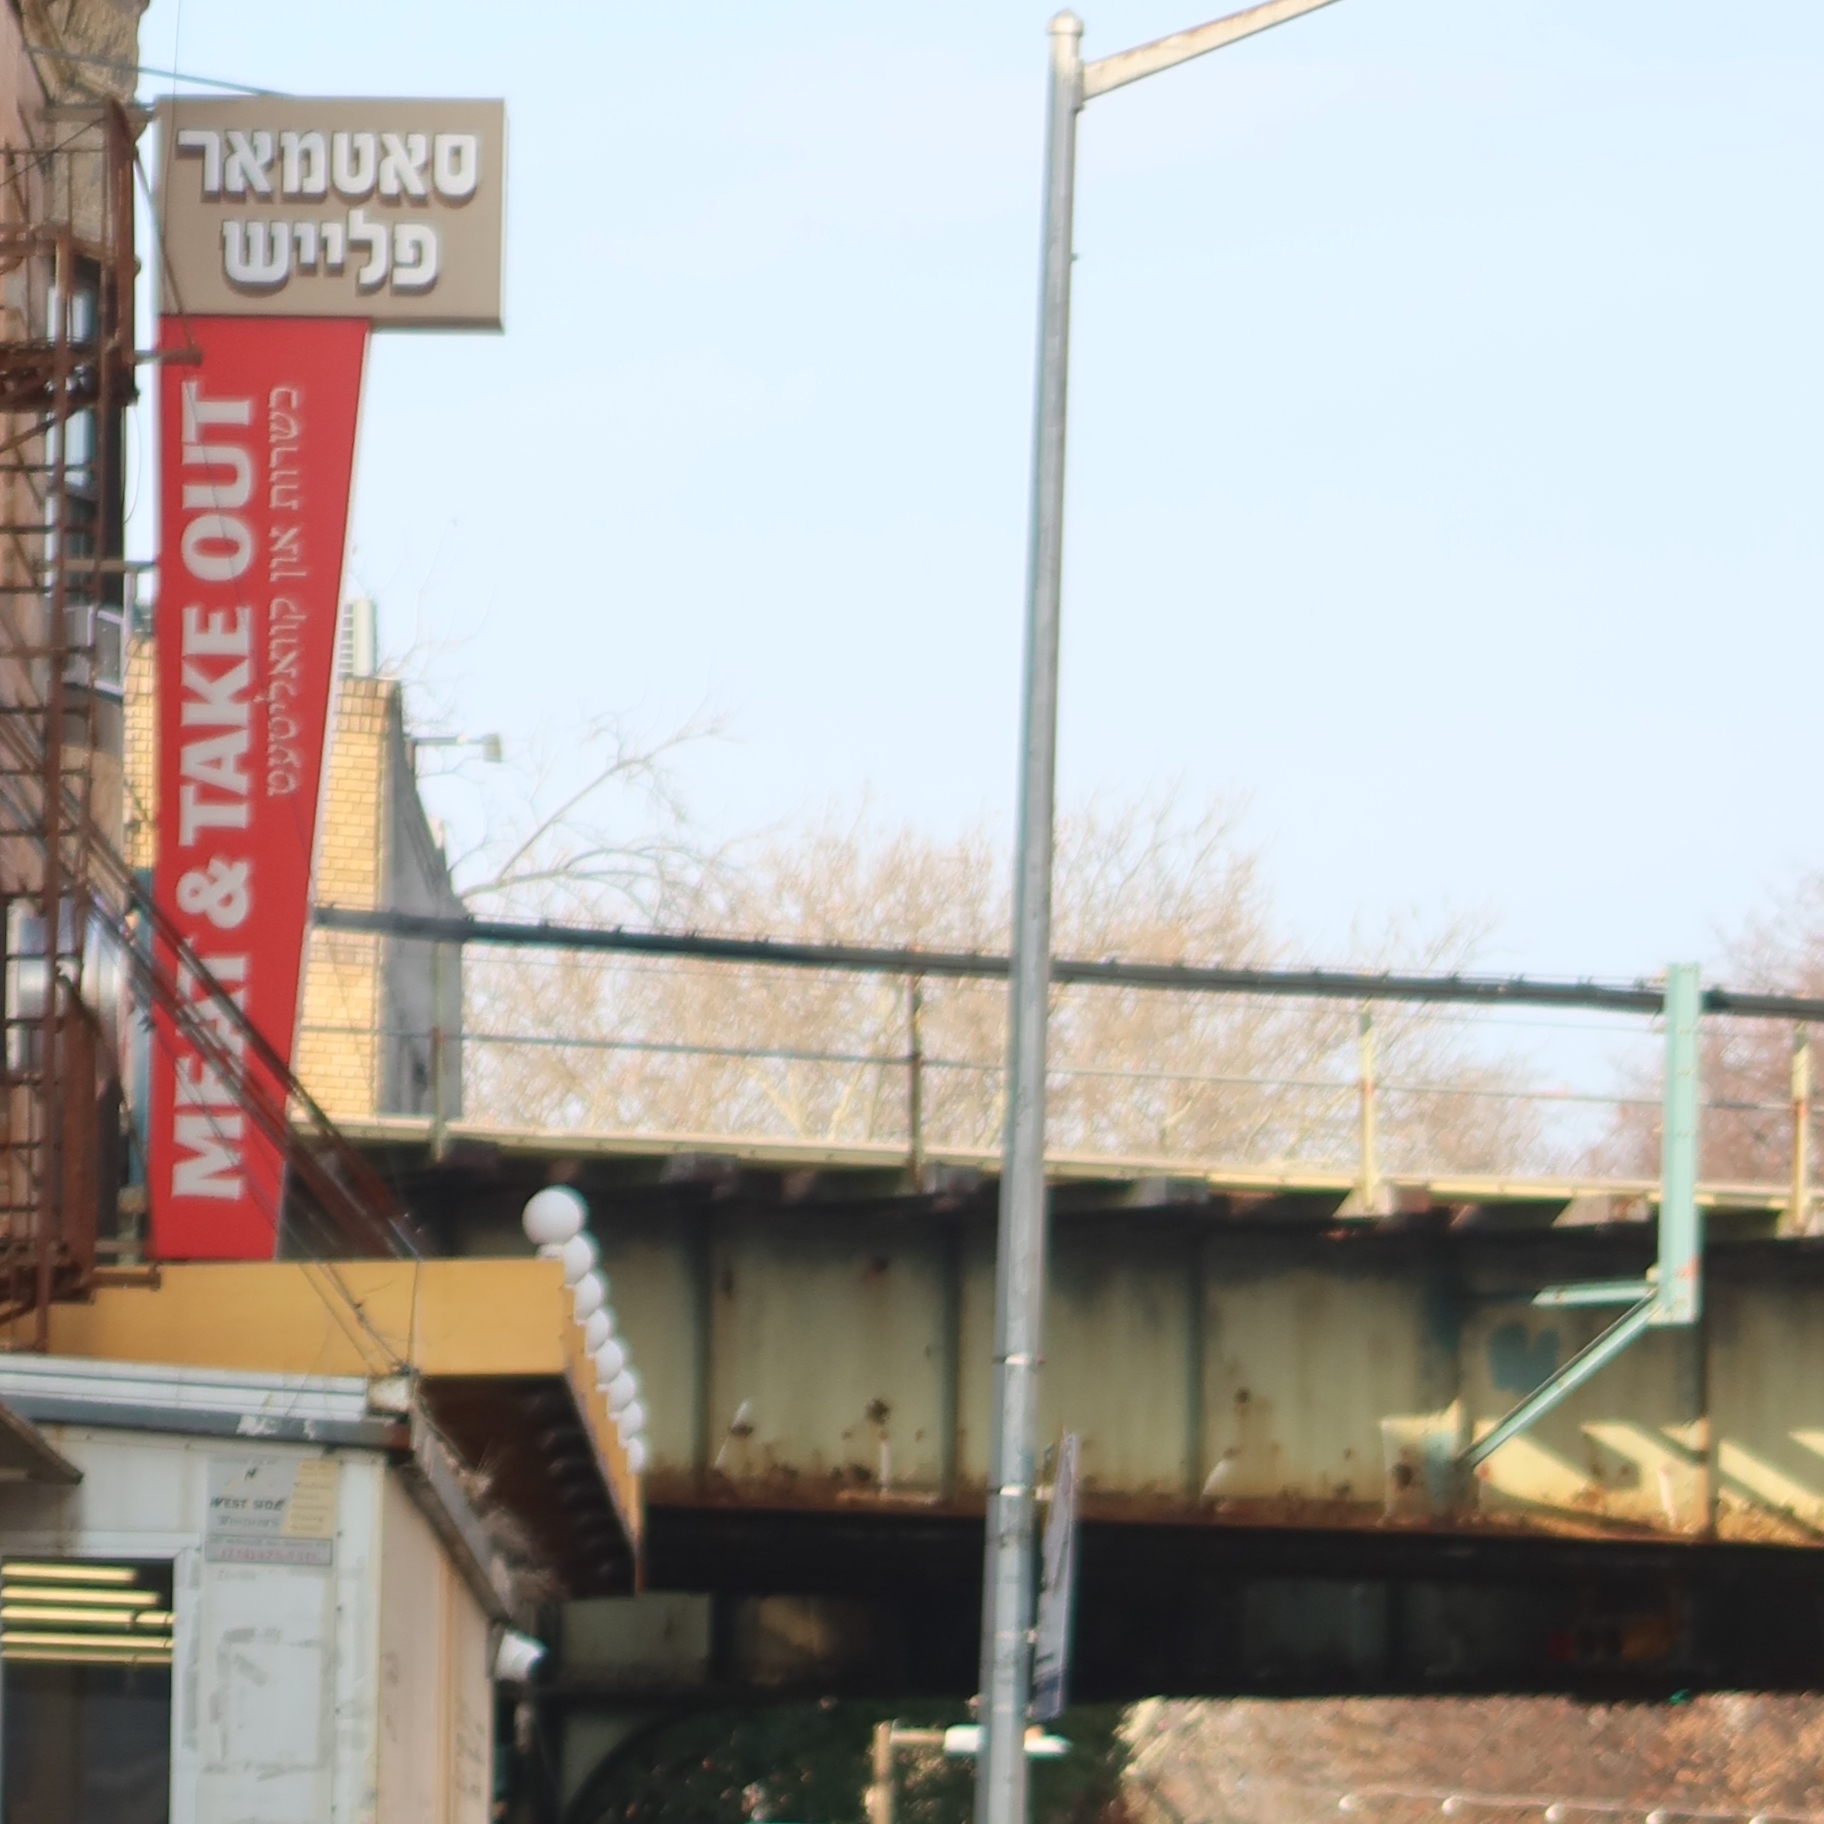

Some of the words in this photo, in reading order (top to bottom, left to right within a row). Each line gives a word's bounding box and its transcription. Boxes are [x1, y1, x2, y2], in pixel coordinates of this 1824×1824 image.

[178, 130, 476, 197] סאטמאר
[223, 209, 438, 286] פלייש
[180, 381, 251, 582] OUT
[268, 386, 300, 511] כשרות
[268, 524, 307, 582] און
[178, 606, 250, 847] TAKE
[175, 856, 249, 929] &
[172, 937, 249, 1199] MEAT
